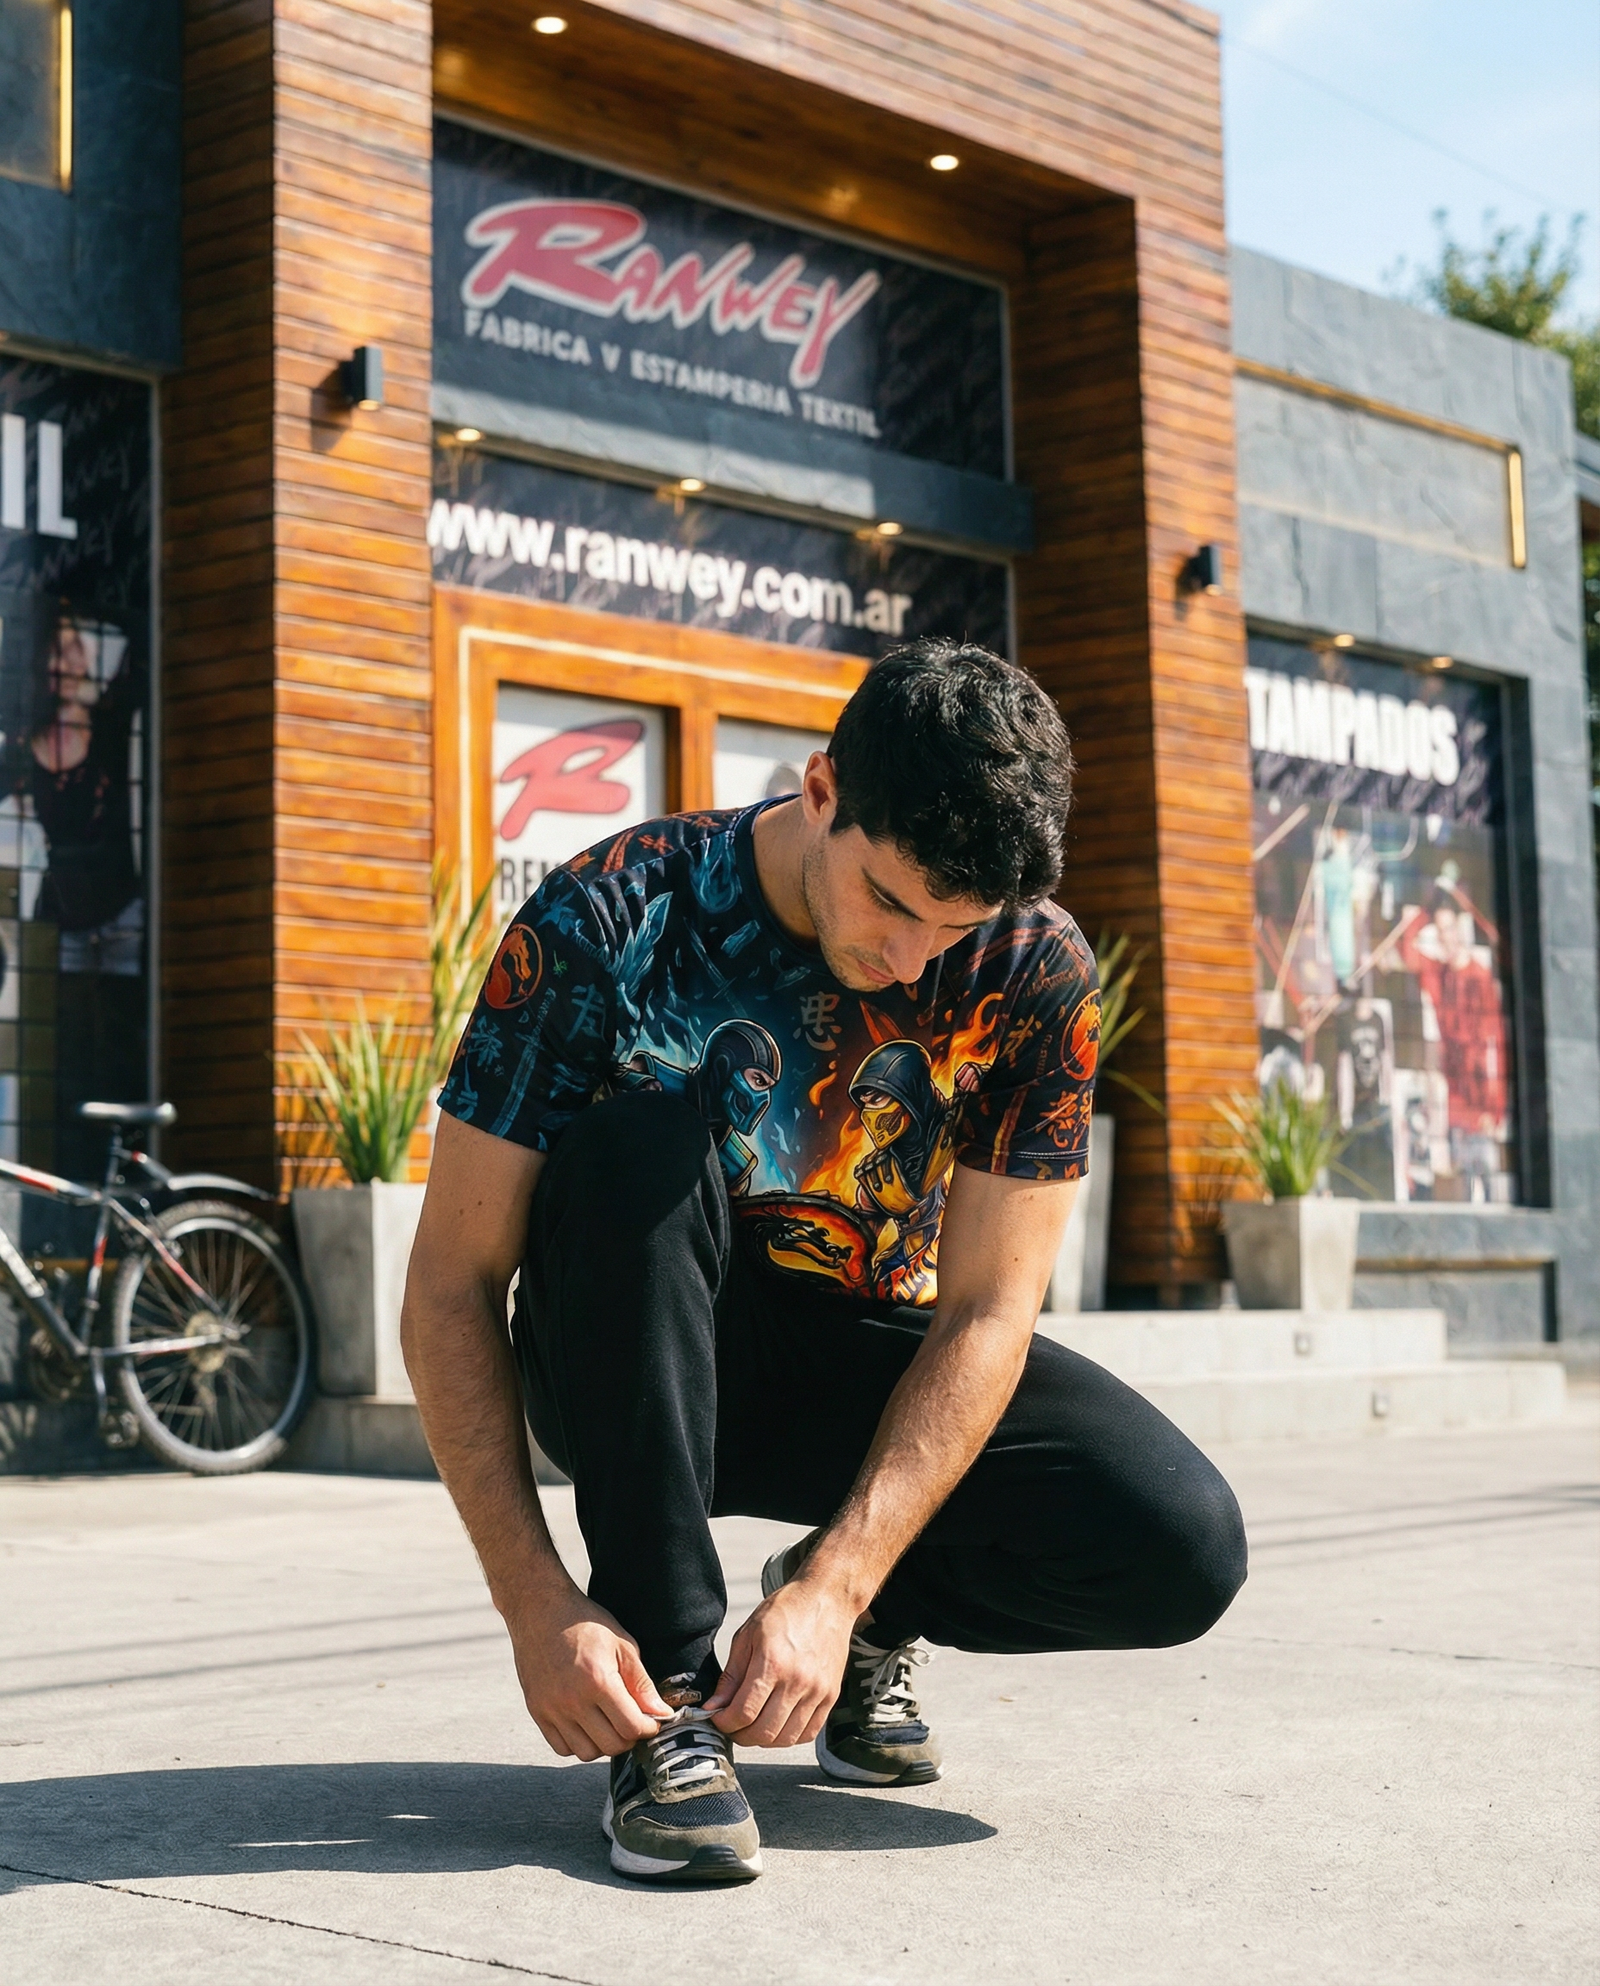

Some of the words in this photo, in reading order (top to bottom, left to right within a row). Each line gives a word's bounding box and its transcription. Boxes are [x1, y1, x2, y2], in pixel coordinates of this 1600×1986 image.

[464, 308, 592, 367] FABRICA
[799, 392, 882, 439] TEXTIL
[426, 497, 913, 637] www.ranwey.com.ar
